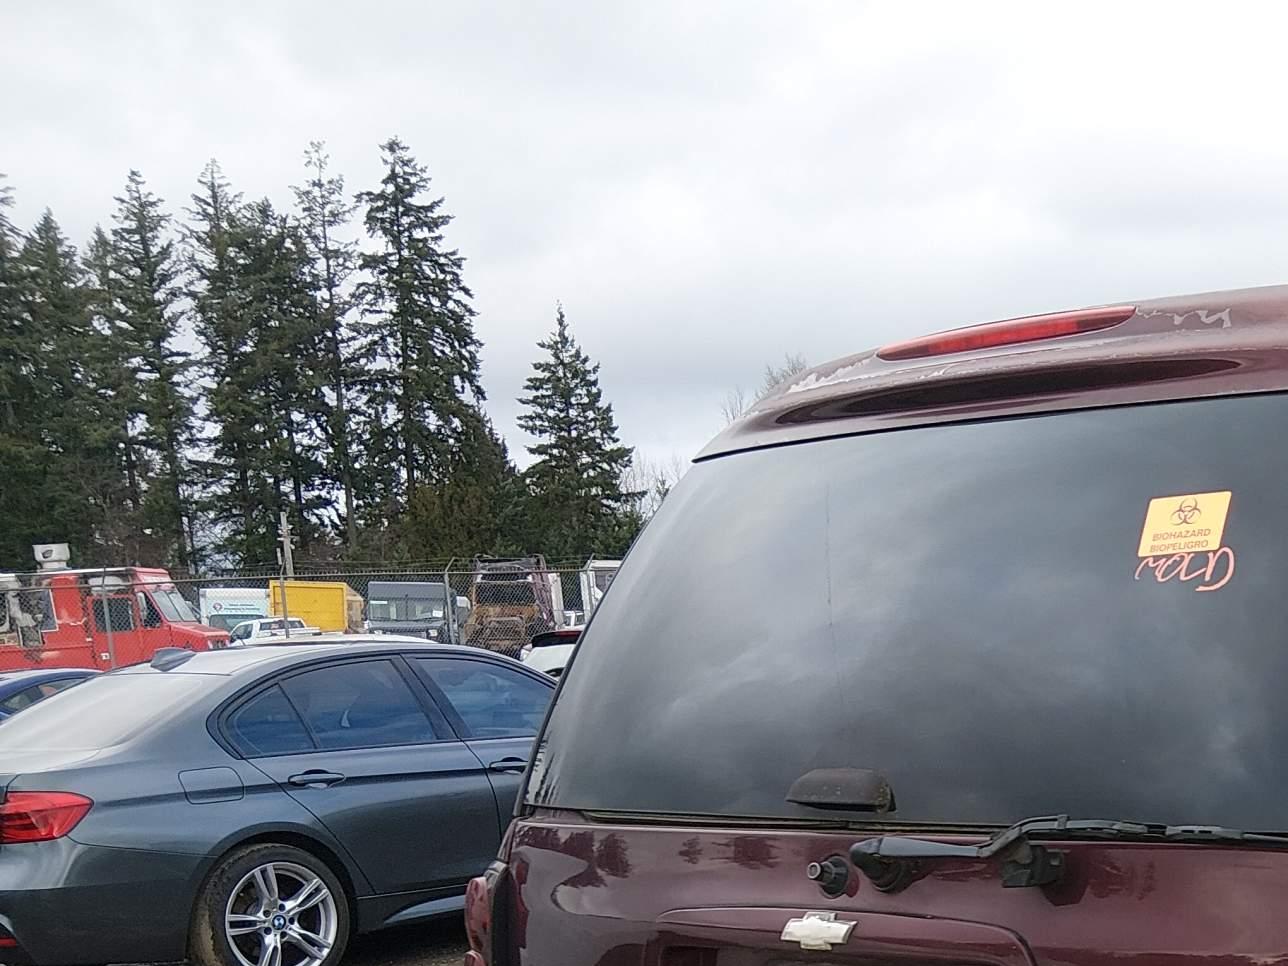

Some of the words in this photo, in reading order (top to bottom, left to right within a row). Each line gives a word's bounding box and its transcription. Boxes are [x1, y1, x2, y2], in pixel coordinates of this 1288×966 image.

[1151, 528, 1212, 542] BIOHAZARD
[1149, 540, 1209, 553] BIOPELIGRO
[1134, 547, 1235, 591] MOLD
